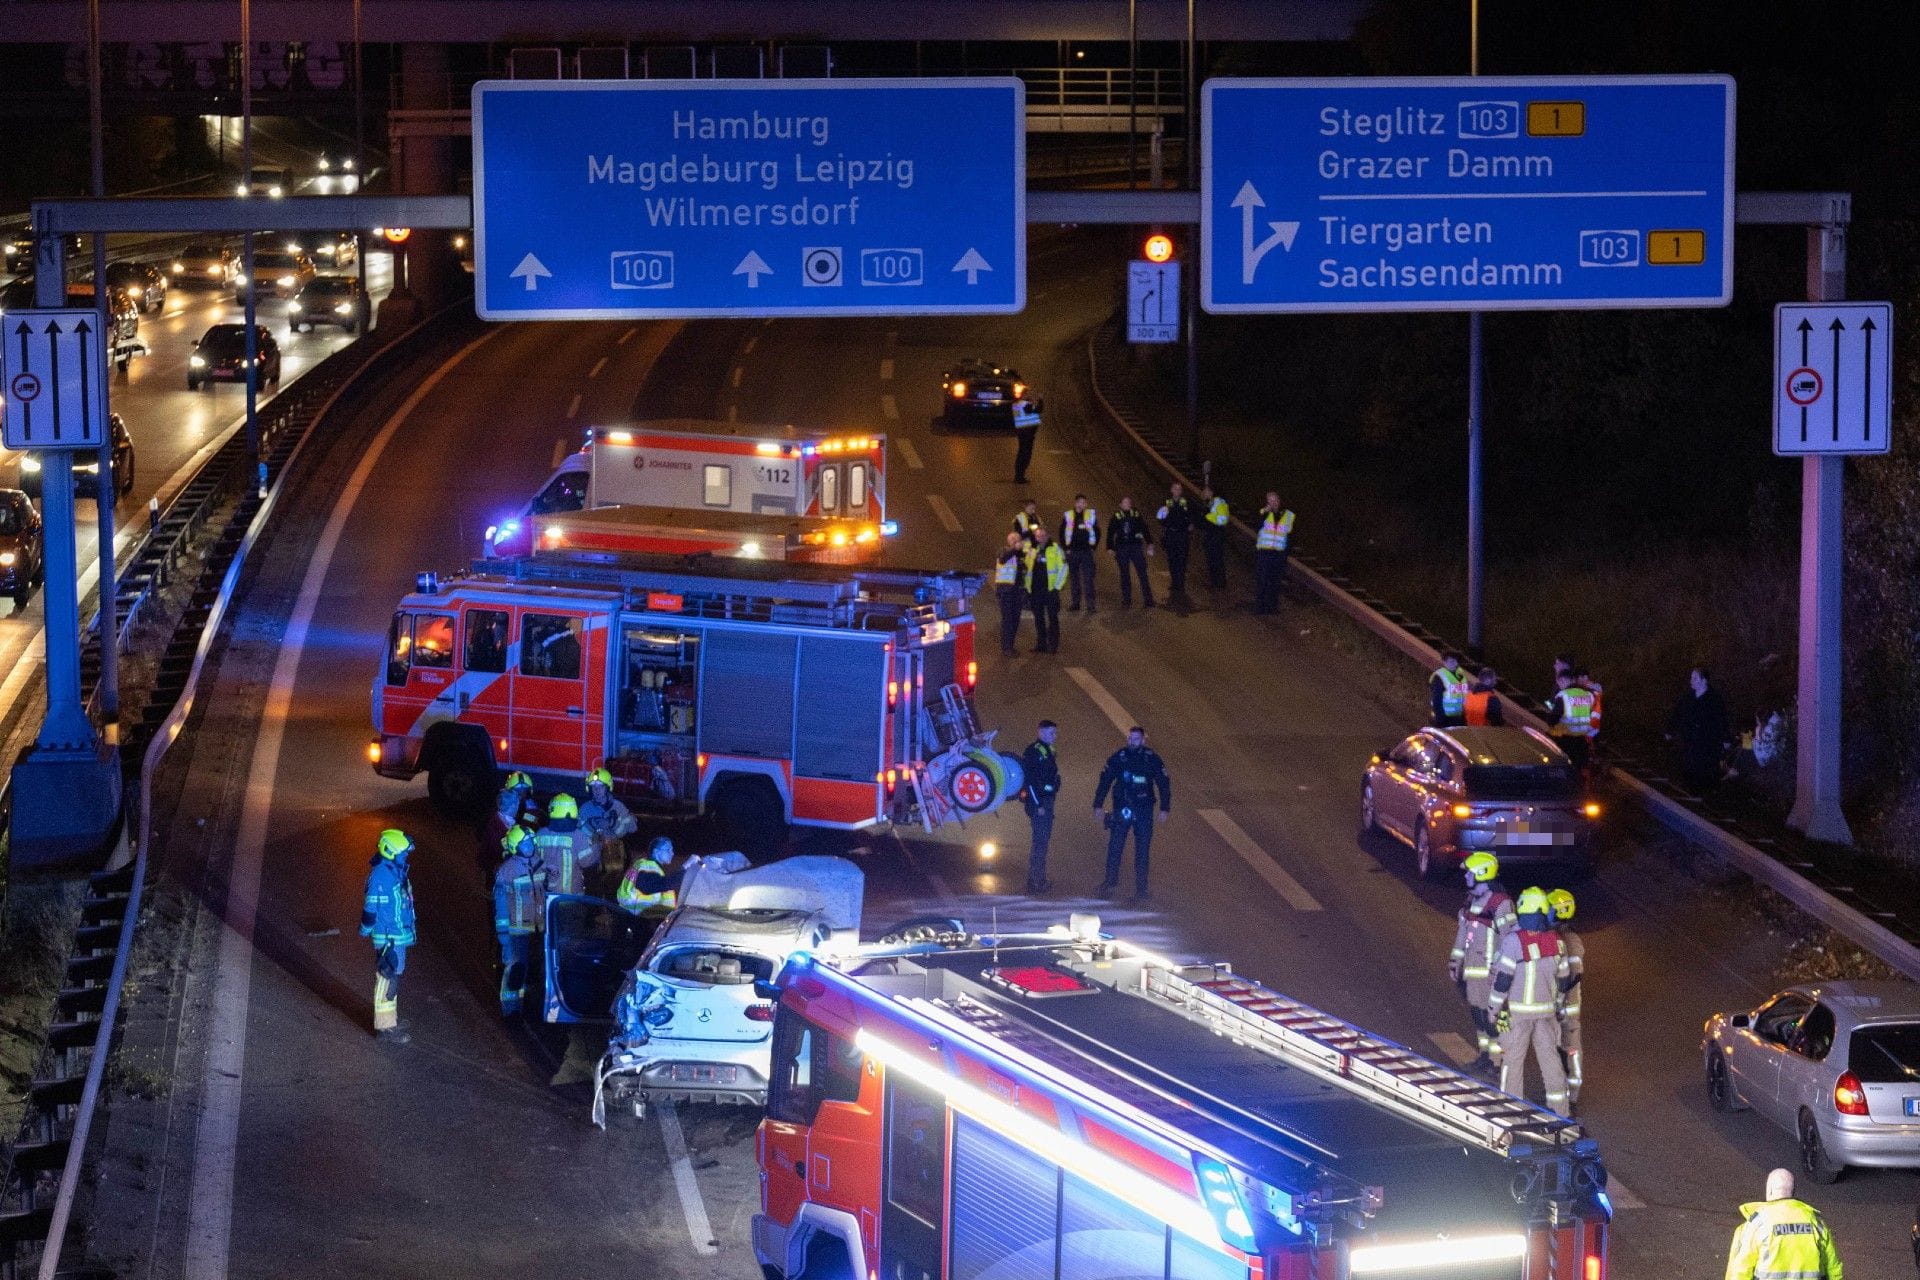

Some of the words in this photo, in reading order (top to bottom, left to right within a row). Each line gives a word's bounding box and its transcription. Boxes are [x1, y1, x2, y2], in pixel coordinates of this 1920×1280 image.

[673, 110, 829, 146] Hamburg
[1320, 107, 1444, 142] Steglitz
[1470, 107, 1508, 131] 103
[1552, 108, 1560, 131] 1
[588, 154, 778, 191] Magdeburg
[796, 153, 914, 190] Leipzig
[1319, 151, 1430, 178] Grazer
[1449, 149, 1553, 178] Damm
[645, 197, 860, 227] Wilmersdorf
[1319, 217, 1492, 252] Tiergarten
[1590, 236, 1629, 260] 103
[1672, 236, 1681, 258] 1
[622, 259, 663, 282] 100
[872, 256, 912, 279] 100
[1319, 258, 1562, 288] Sachsendamm
[1137, 328, 1154, 338] 100
[766, 469, 790, 483] 112
